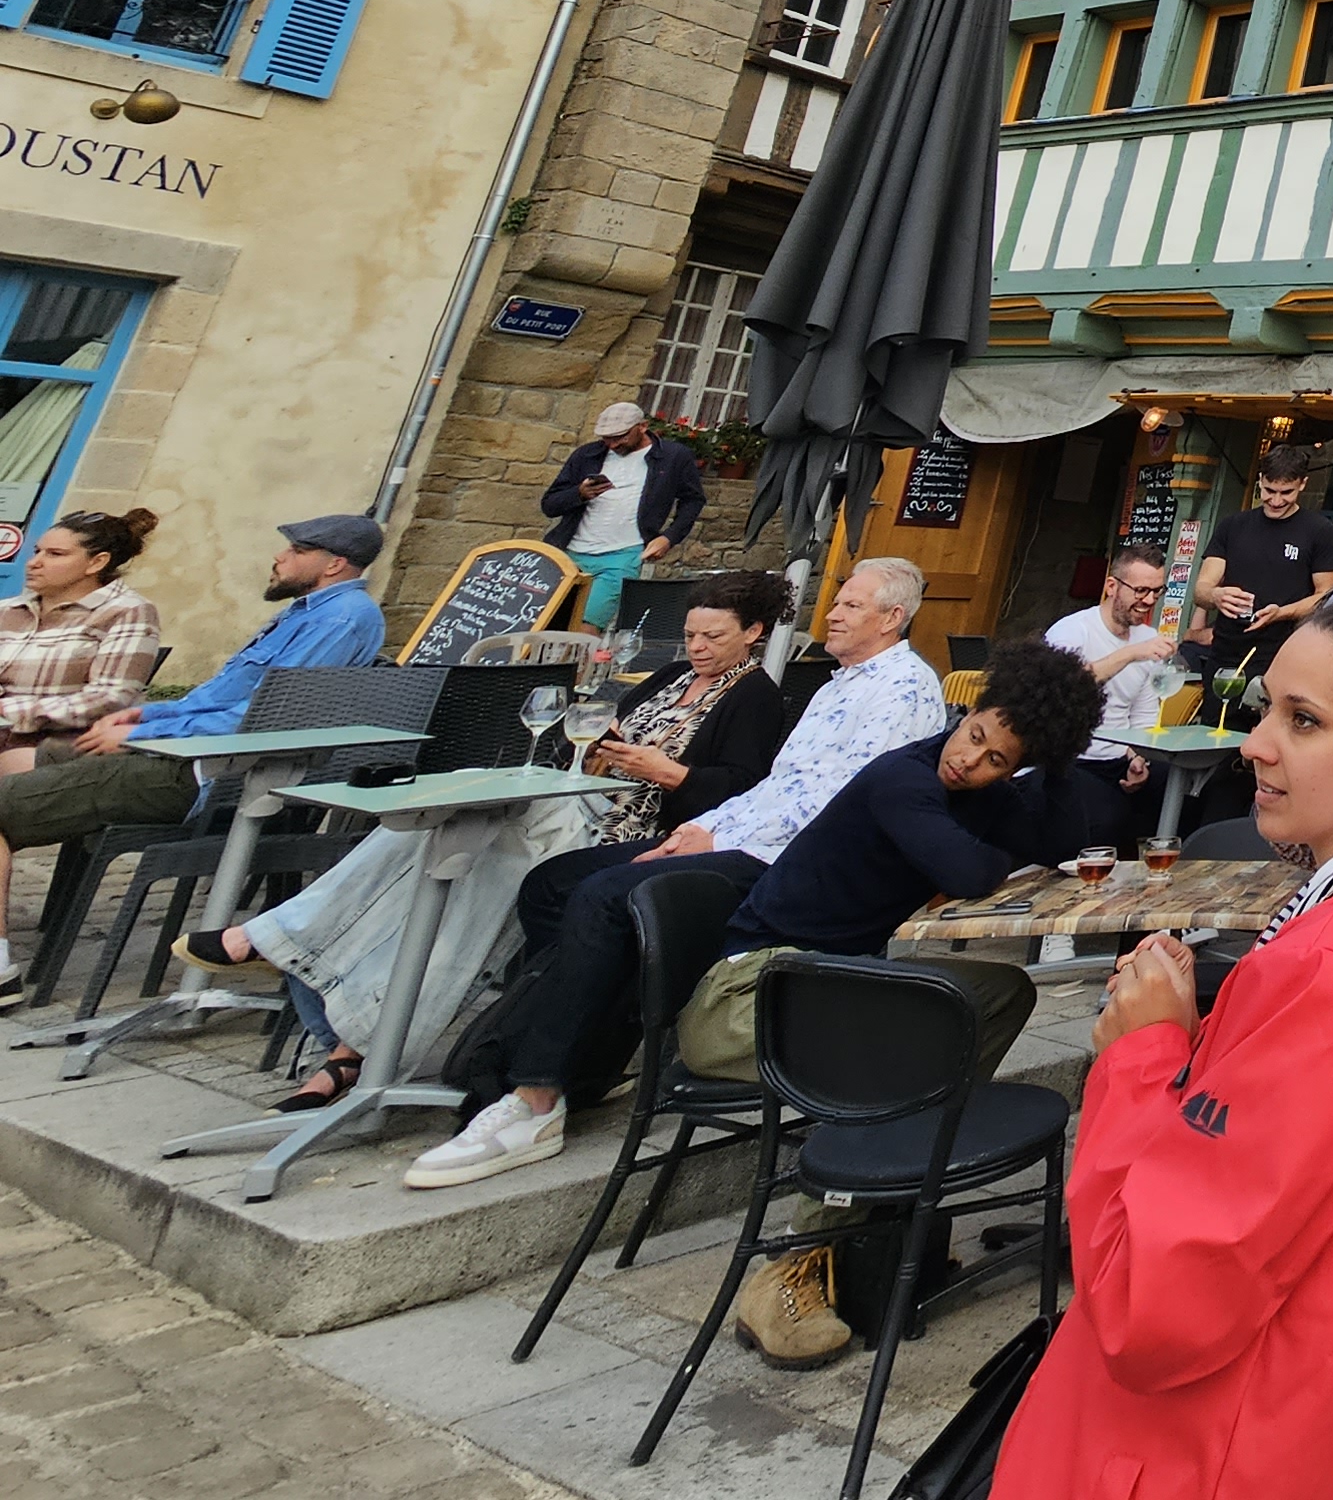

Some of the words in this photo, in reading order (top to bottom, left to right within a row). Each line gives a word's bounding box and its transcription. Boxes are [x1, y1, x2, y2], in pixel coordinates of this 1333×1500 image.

[534, 308, 553, 318] RUE
[505, 316, 518, 325] DU
[520, 318, 543, 329] PETIT
[545, 321, 567, 332] PORT
